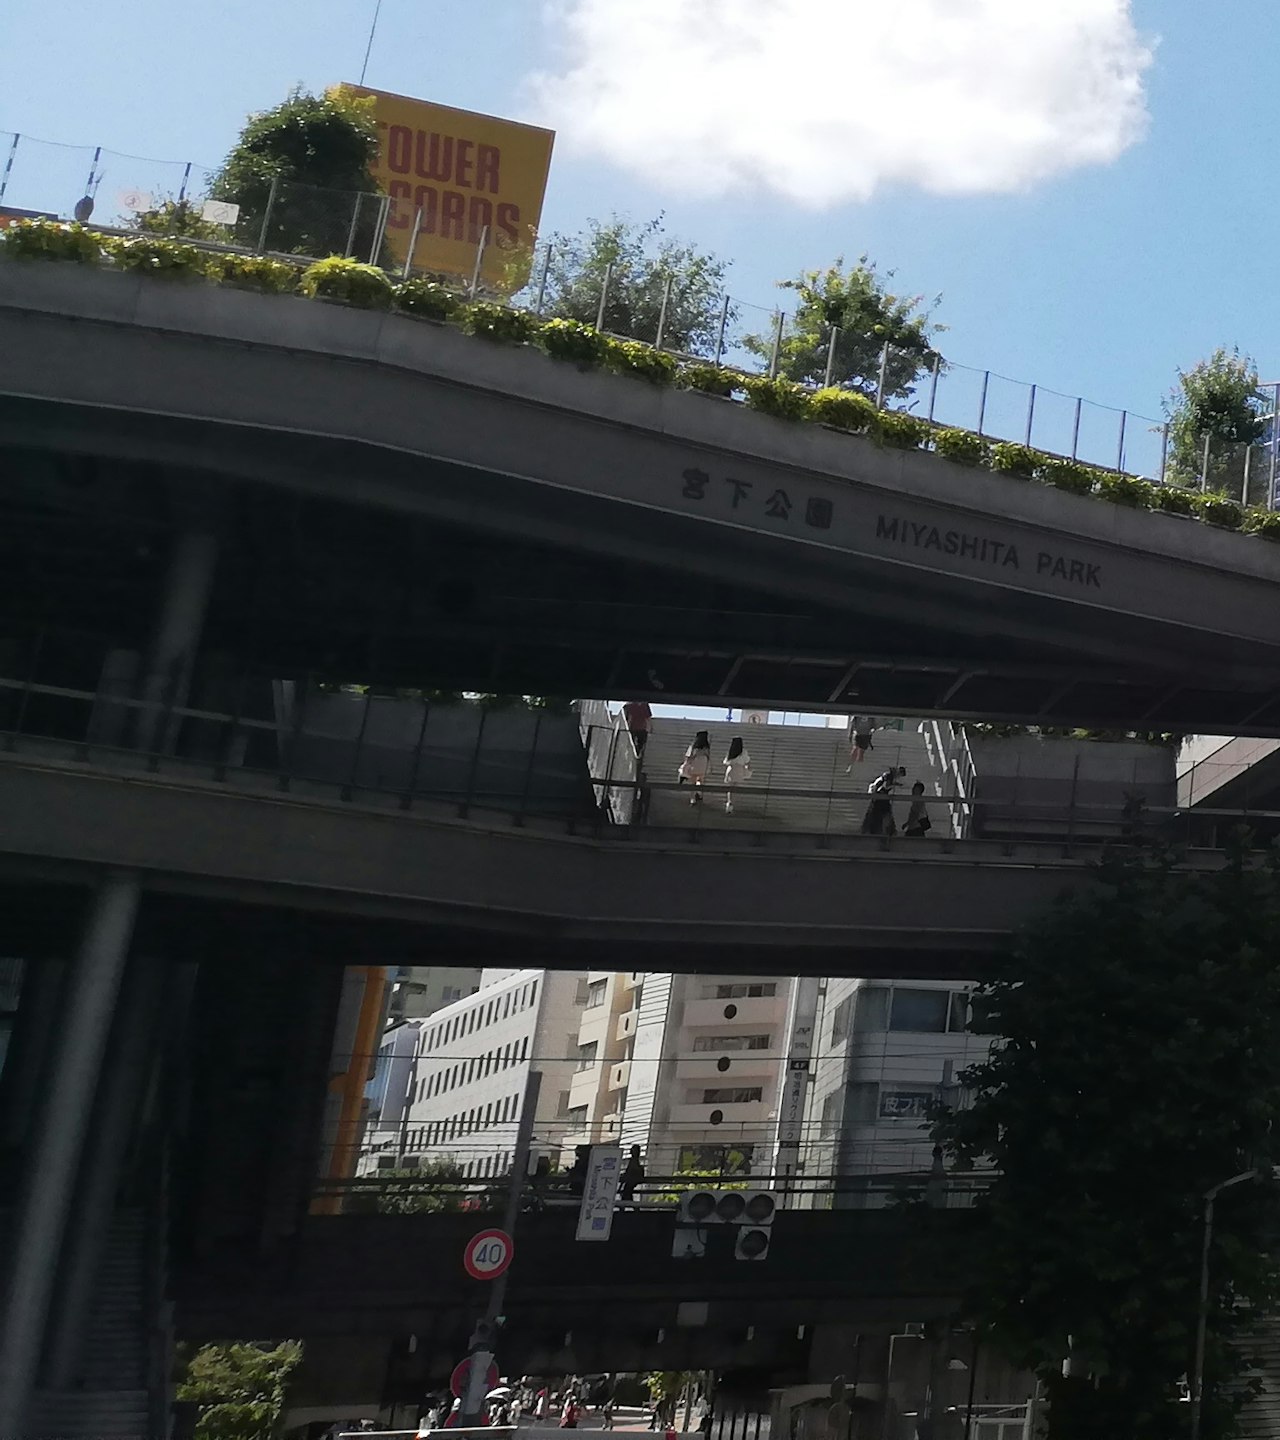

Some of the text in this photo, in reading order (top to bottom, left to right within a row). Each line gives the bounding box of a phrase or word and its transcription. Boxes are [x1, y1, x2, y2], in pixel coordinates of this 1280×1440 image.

[388, 179, 520, 250] CORDS
[681, 467, 834, 530] 宮下公園
[875, 513, 1103, 589] MIYASHITA PARK
[475, 1243, 503, 1265] 40
